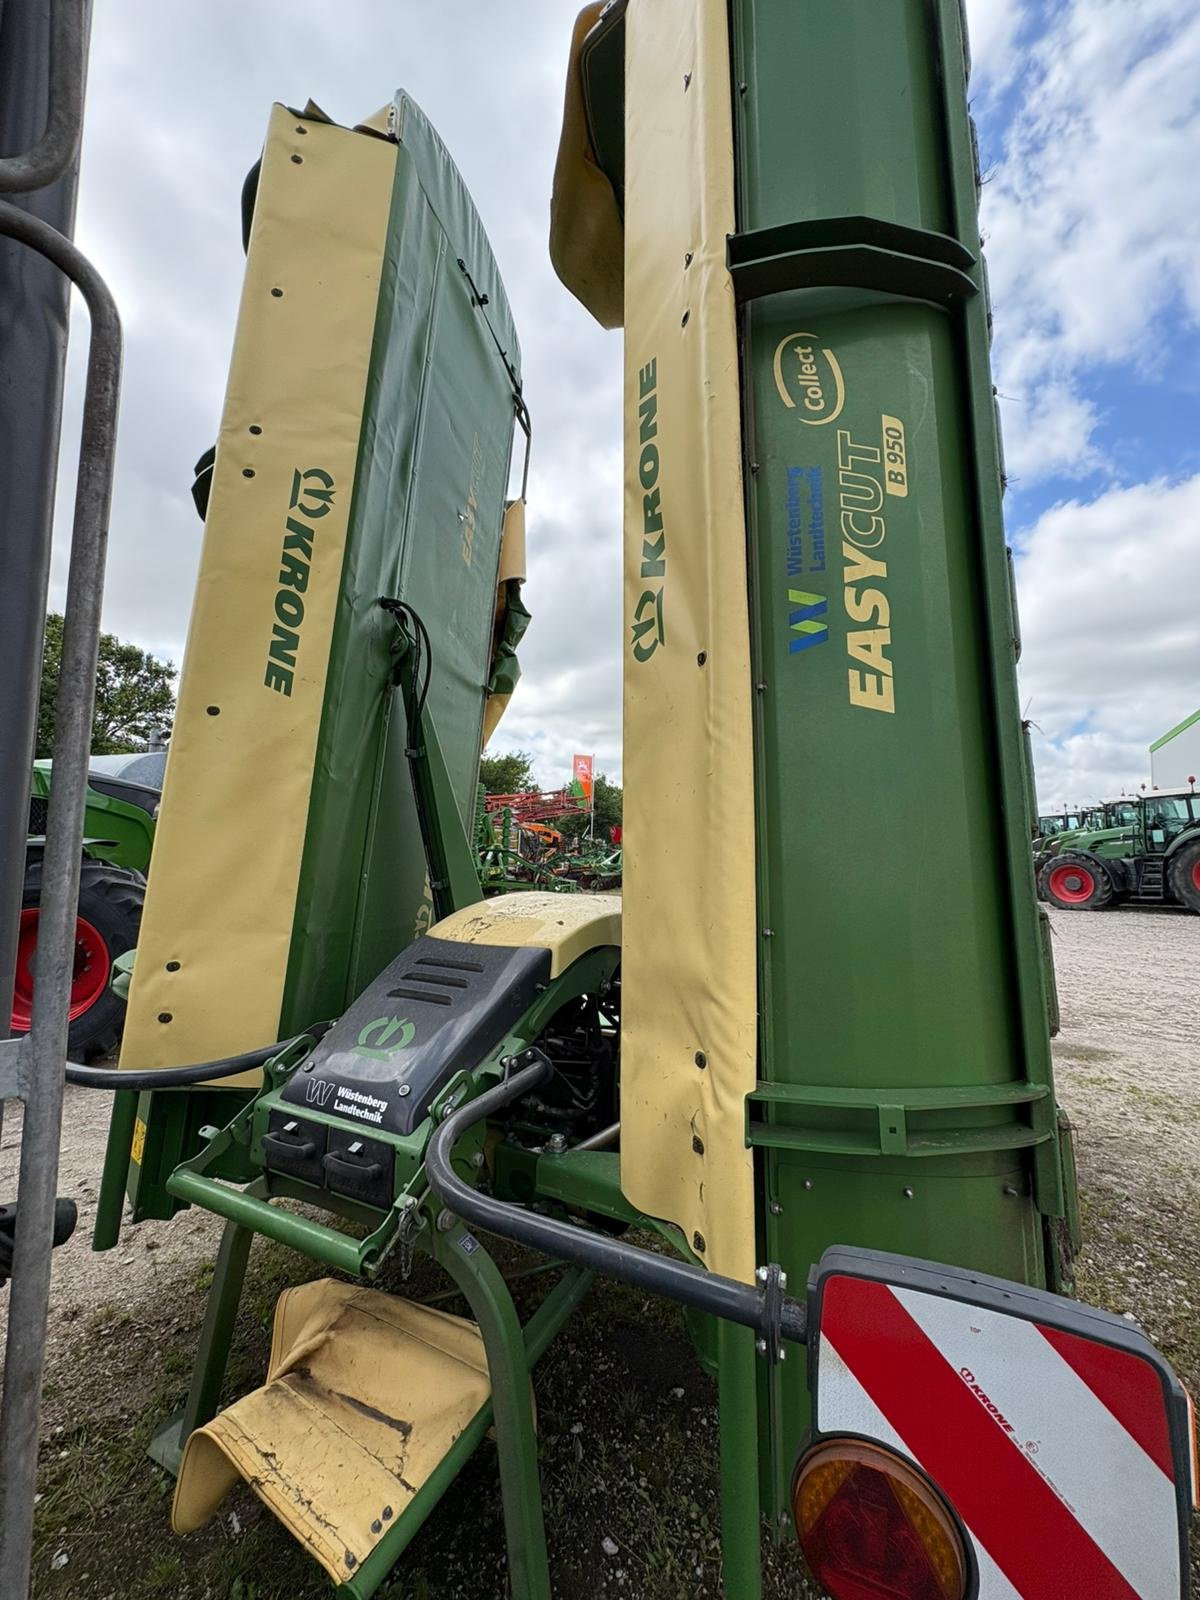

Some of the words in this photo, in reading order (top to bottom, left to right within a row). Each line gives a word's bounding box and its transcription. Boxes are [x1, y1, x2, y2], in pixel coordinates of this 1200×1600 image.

[793, 345, 825, 411] Collect
[638, 356, 667, 579] KRONE
[885, 426, 904, 465] 950
[887, 469, 906, 486] B
[786, 466, 804, 577] Wüstenberg
[809, 464, 827, 572] Landtechnik
[836, 429, 896, 714] EASYCUT
[264, 516, 315, 698] KRONE
[333, 1099, 384, 1124] Landtechnik
[337, 1086, 388, 1112] Wüstenberg
[970, 1326, 981, 1334] TOP
[969, 1384, 1015, 1433] KRONE
